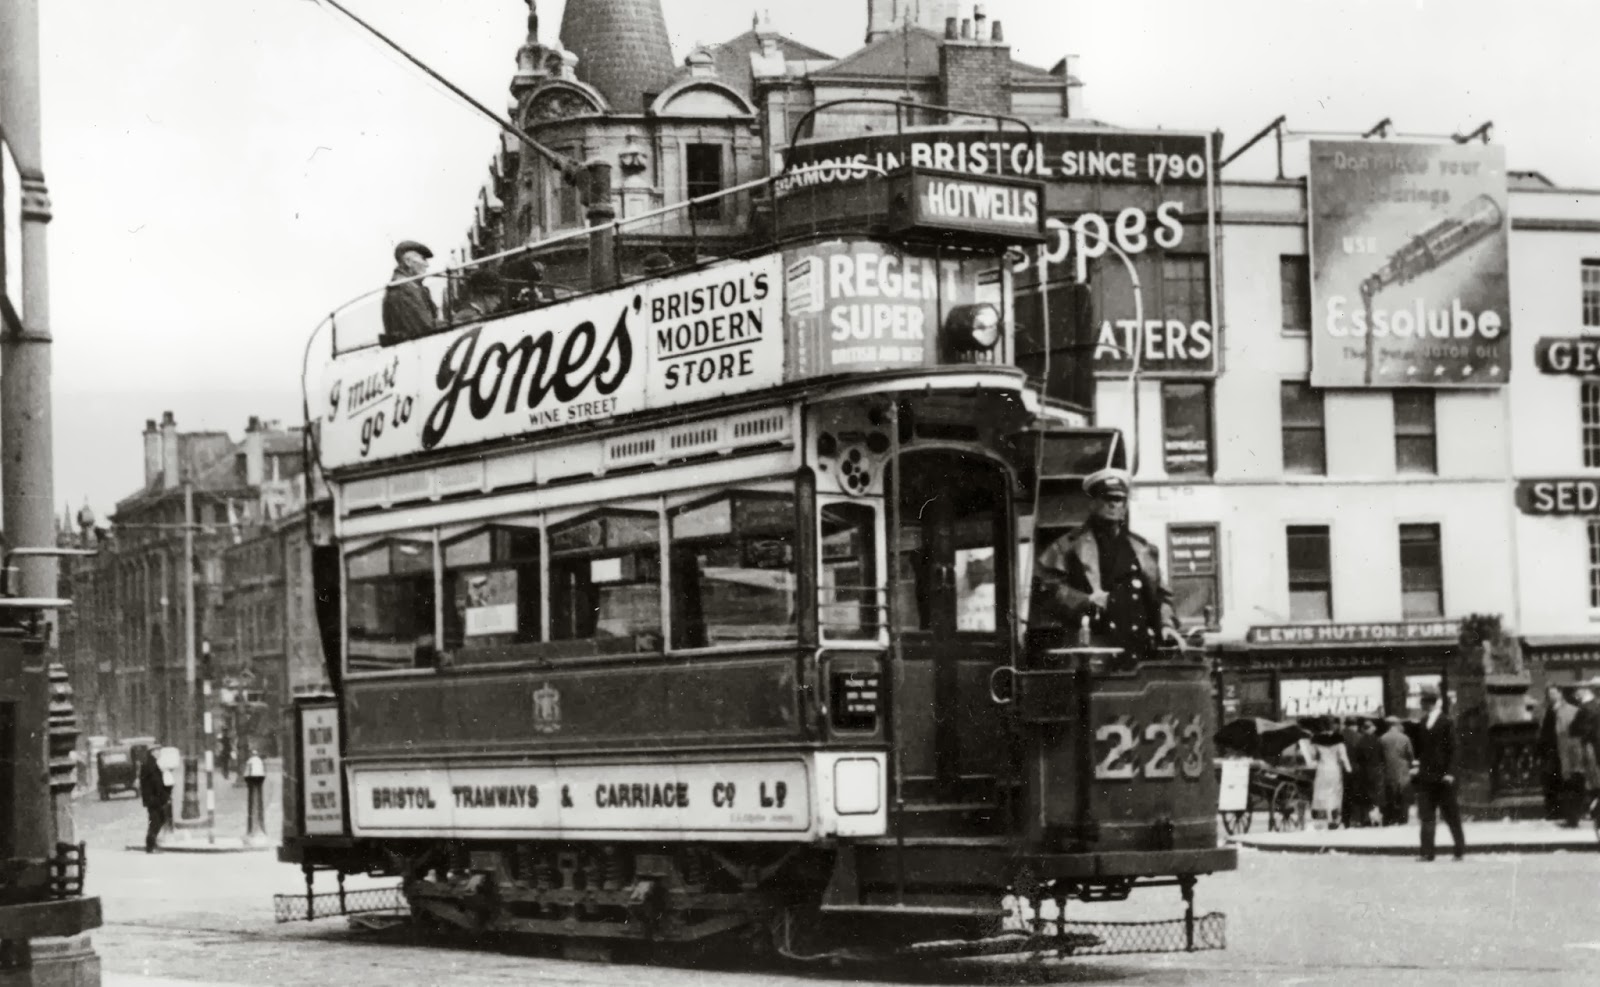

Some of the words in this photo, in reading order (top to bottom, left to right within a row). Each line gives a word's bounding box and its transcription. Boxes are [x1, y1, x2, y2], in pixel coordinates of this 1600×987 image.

[775, 153, 868, 190] AMOUS
[876, 150, 905, 181] IN
[911, 142, 1052, 175] BRISTOL
[1062, 152, 1137, 177] SINCE
[1148, 153, 1204, 184] 1790
[928, 181, 1038, 224] HOTWELLS
[651, 272, 769, 323] BRISTOL'S
[830, 253, 960, 301] REGENT
[657, 307, 763, 352] MODERN
[831, 304, 925, 341] SUPER
[1326, 295, 1502, 338] Essolube
[421, 294, 643, 449] Jones'
[665, 350, 754, 390] STORE
[1548, 341, 1600, 372] GE
[347, 355, 400, 412] must
[361, 411, 385, 456] go
[392, 394, 414, 428] to
[529, 409, 561, 427] WINE
[568, 397, 618, 421] STREET
[1533, 481, 1600, 512] SED
[1256, 627, 1315, 642] LEWIS
[1318, 625, 1398, 640] HUTTON
[1095, 722, 1203, 780] 223
[372, 787, 436, 809] BRISTOL
[453, 786, 538, 809] TRAMWAYS
[560, 787, 574, 808] &
[595, 782, 690, 809] CARRIAGE
